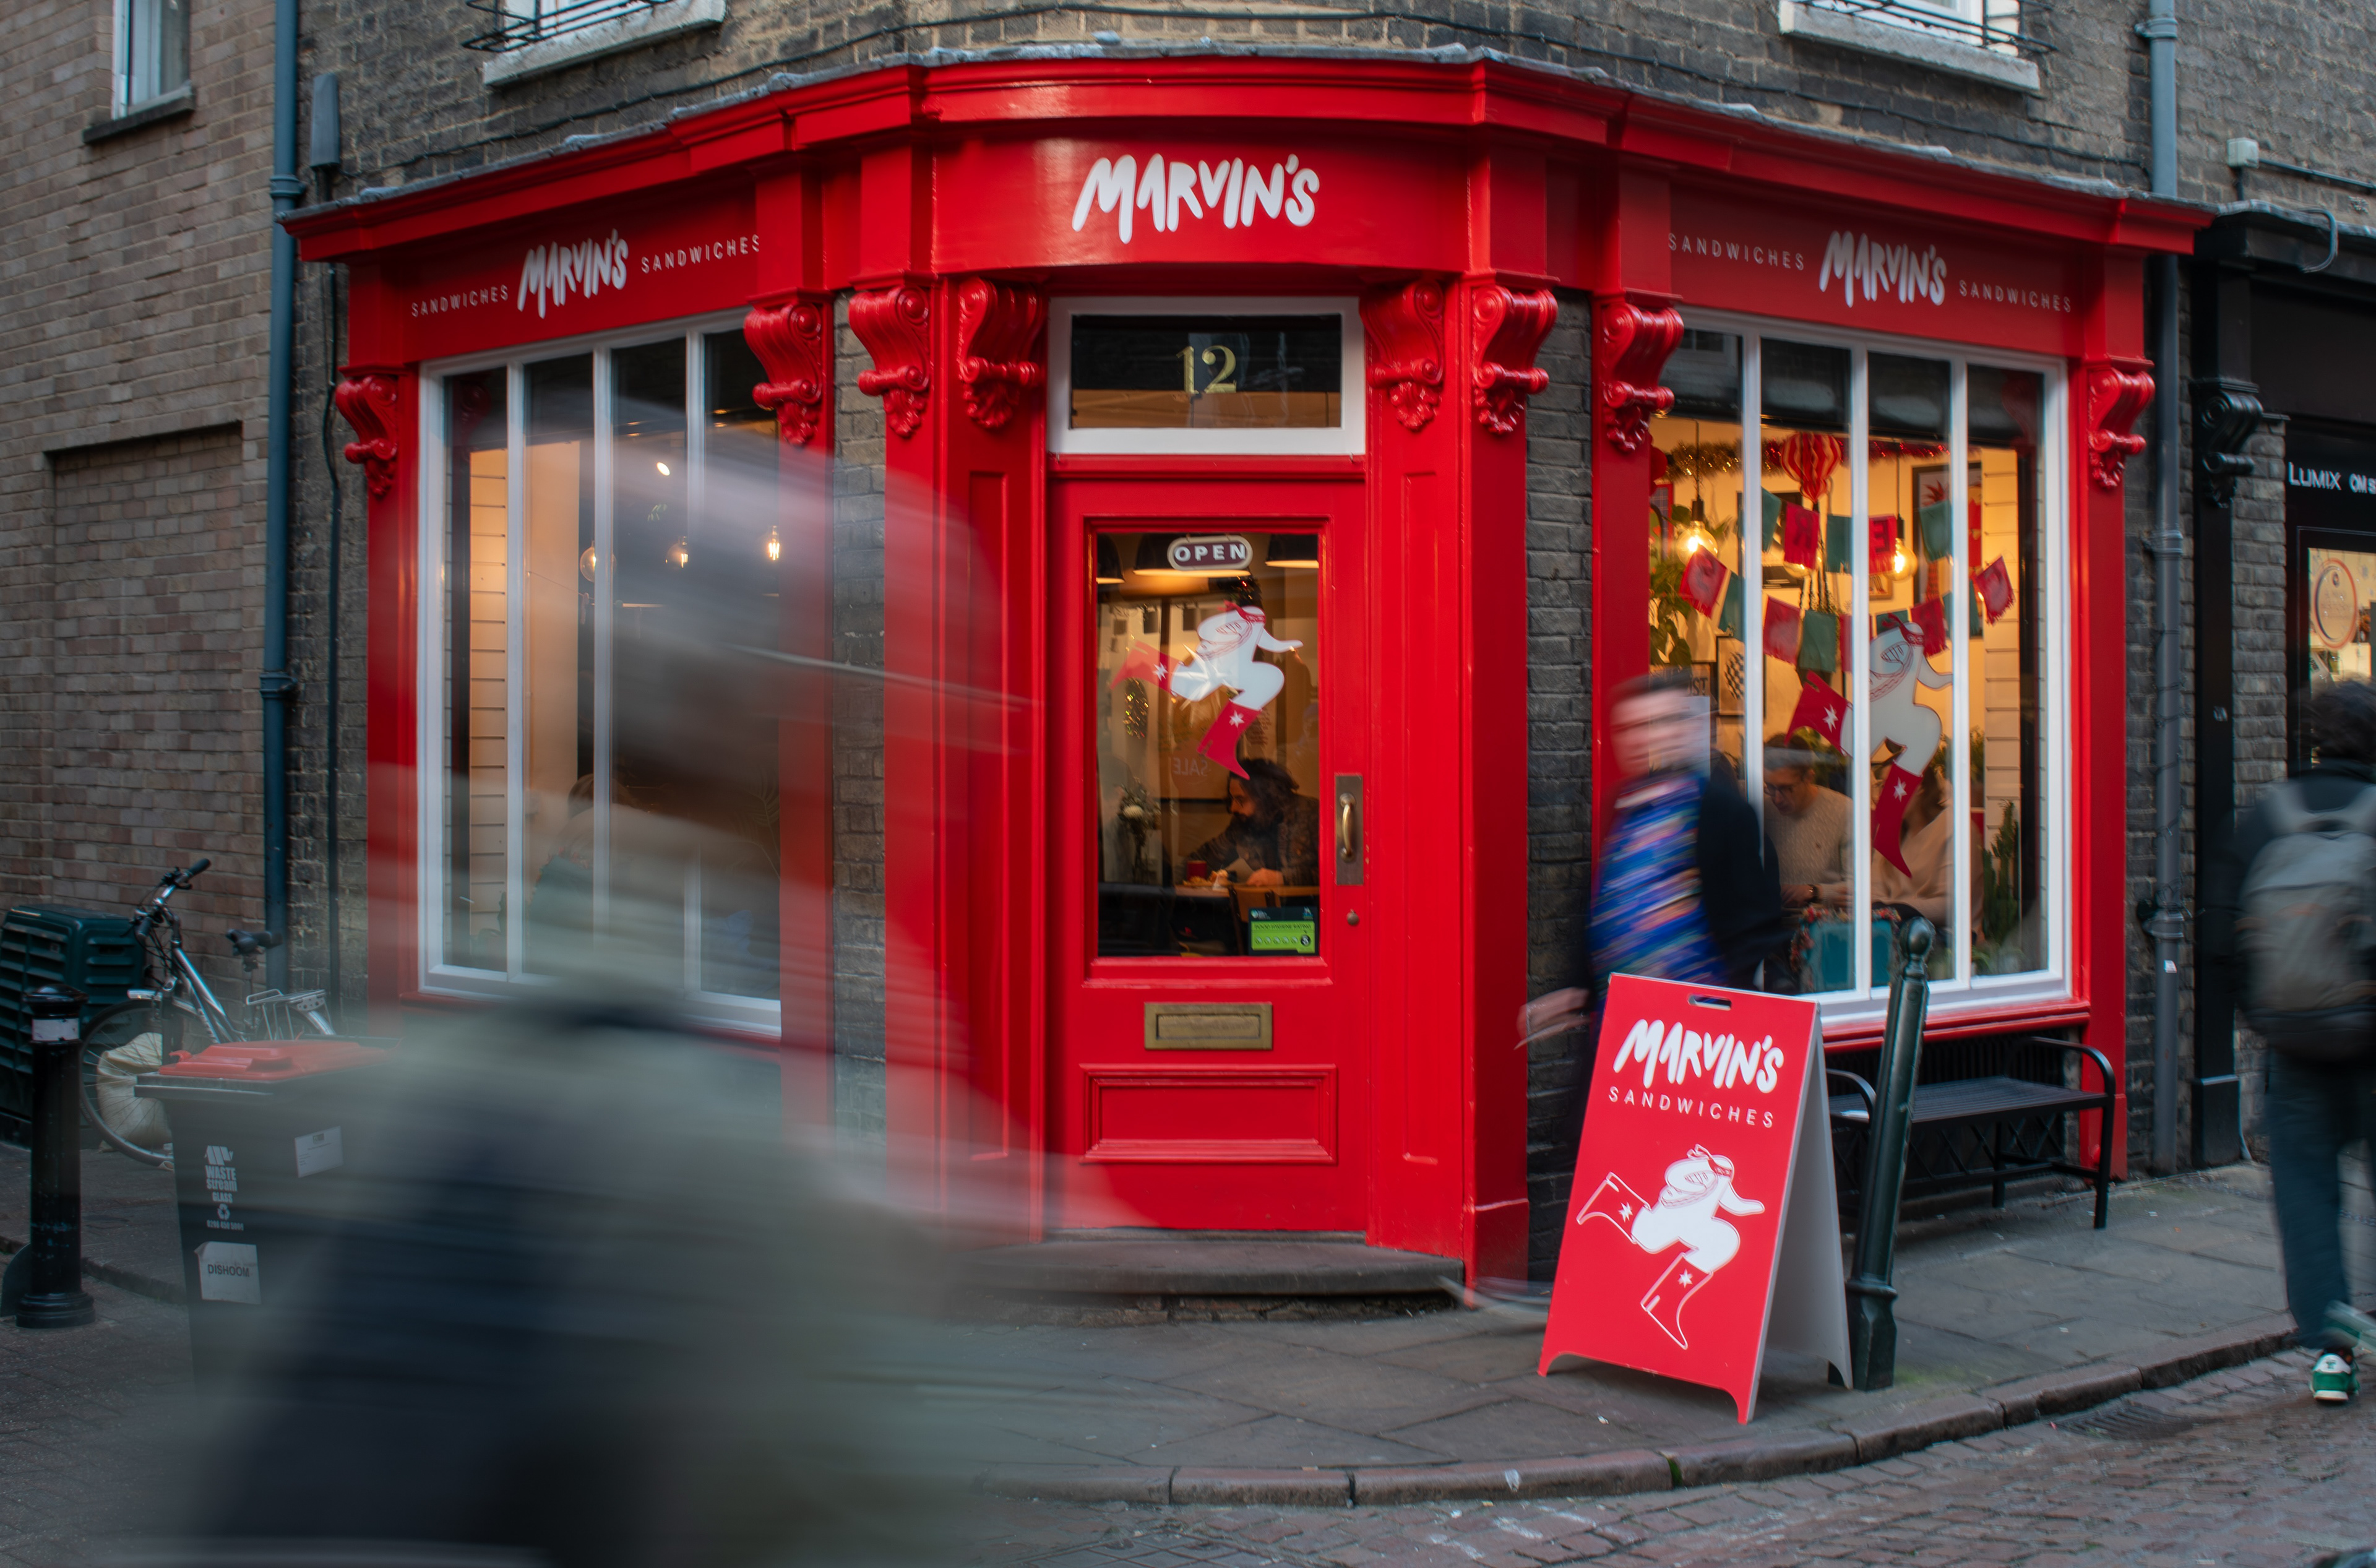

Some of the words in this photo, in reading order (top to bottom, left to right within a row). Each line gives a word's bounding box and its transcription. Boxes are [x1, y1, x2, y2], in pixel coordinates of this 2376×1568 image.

[1072, 153, 1320, 244] MARVIN'S
[411, 284, 509, 318] SANDWICHES
[517, 228, 629, 319] MARVIN'S
[641, 235, 760, 274] SANDWICHES
[1668, 233, 1804, 270] SANDWICHES
[1819, 230, 1947, 308] MARVIN'S
[1959, 280, 2072, 313] SANDWICHES
[1176, 345, 1237, 395] 12
[2289, 462, 2341, 491] LUMIX
[1175, 543, 1247, 562] OPEN
[1613, 1019, 1784, 1094] MARVIN'S
[1608, 1086, 1773, 1128] SANDWICHES
[205, 1165, 237, 1181] WASTE
[207, 1178, 238, 1192] stream
[212, 1191, 233, 1203] GLASS
[208, 1264, 249, 1277] DISHOOM
